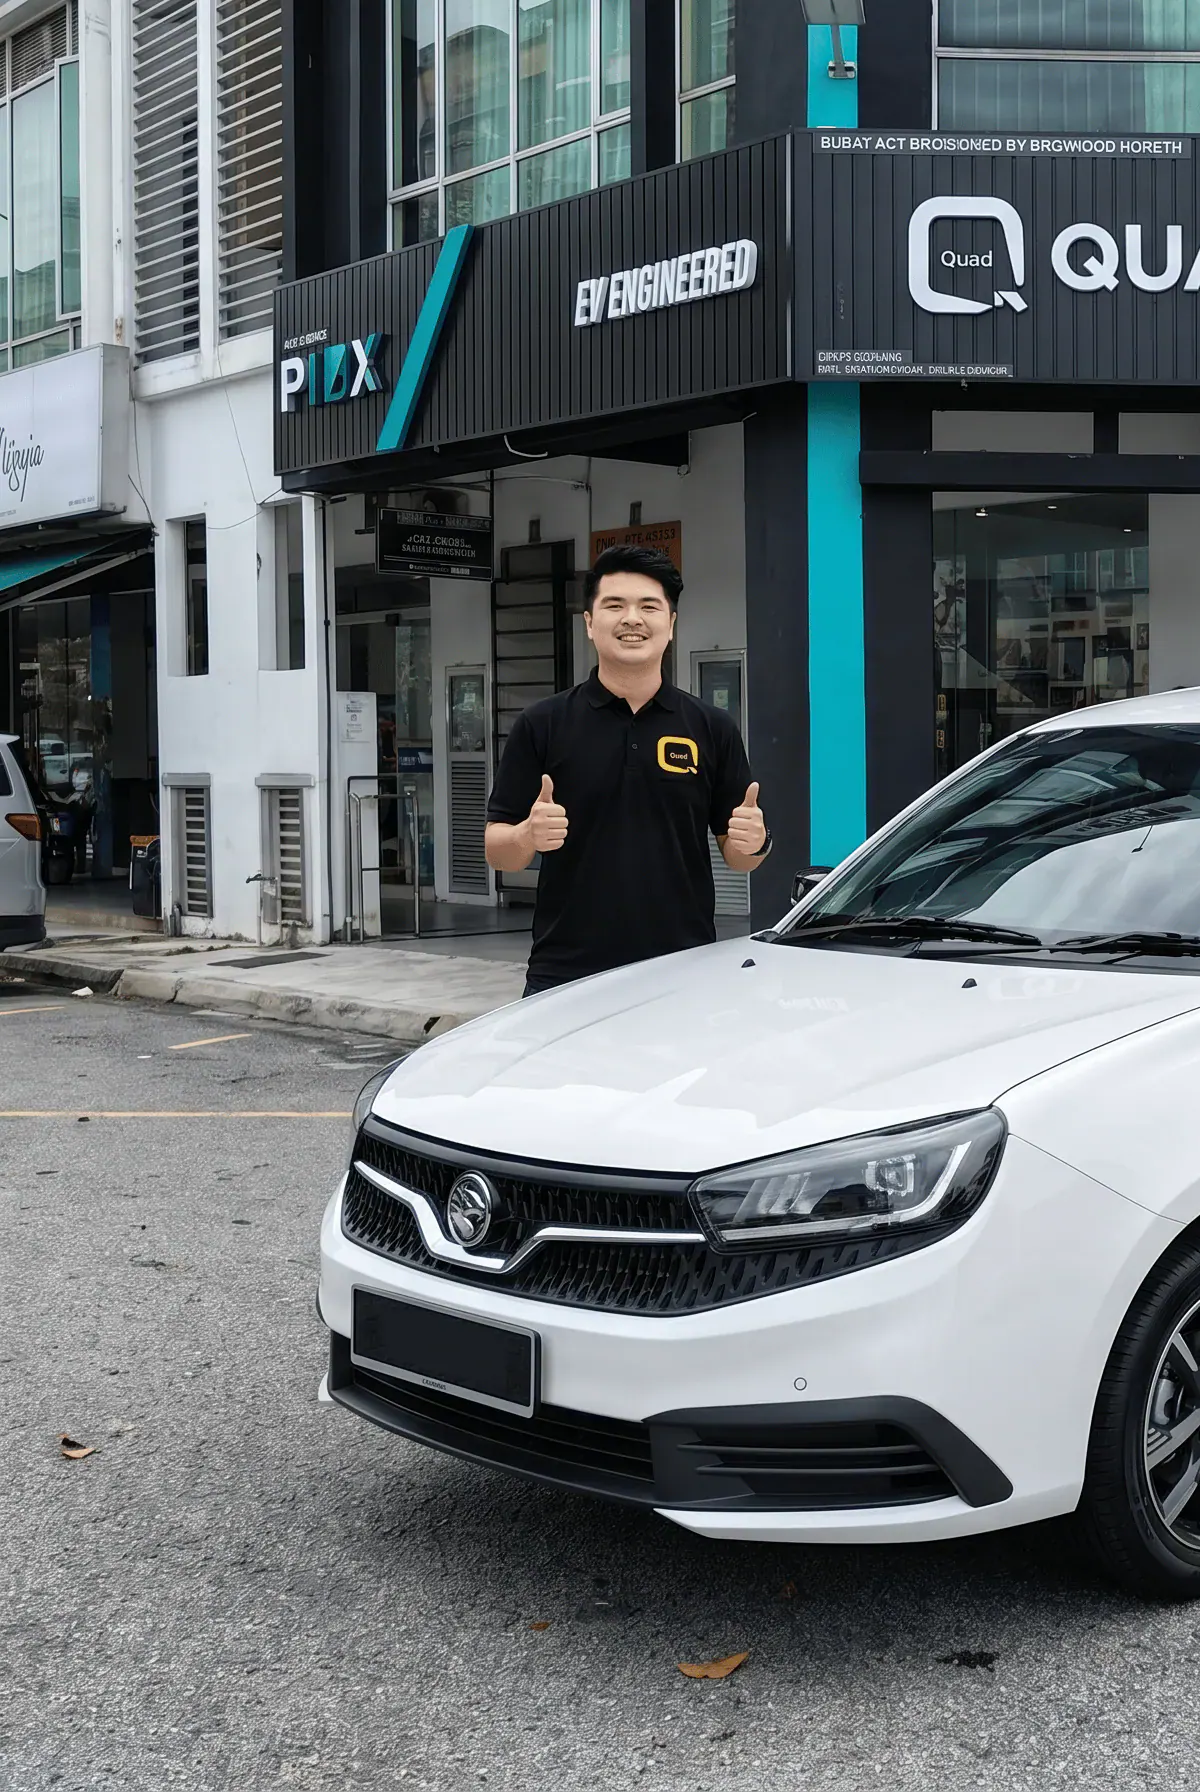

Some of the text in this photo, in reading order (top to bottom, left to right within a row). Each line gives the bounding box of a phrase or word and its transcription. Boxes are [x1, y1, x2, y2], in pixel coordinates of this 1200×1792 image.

[874, 137, 907, 151] ACT
[1006, 139, 1027, 152] BY
[1119, 141, 1183, 154] HORETH
[941, 249, 993, 268] Quad
[574, 238, 758, 327] EV ENGINEERED
